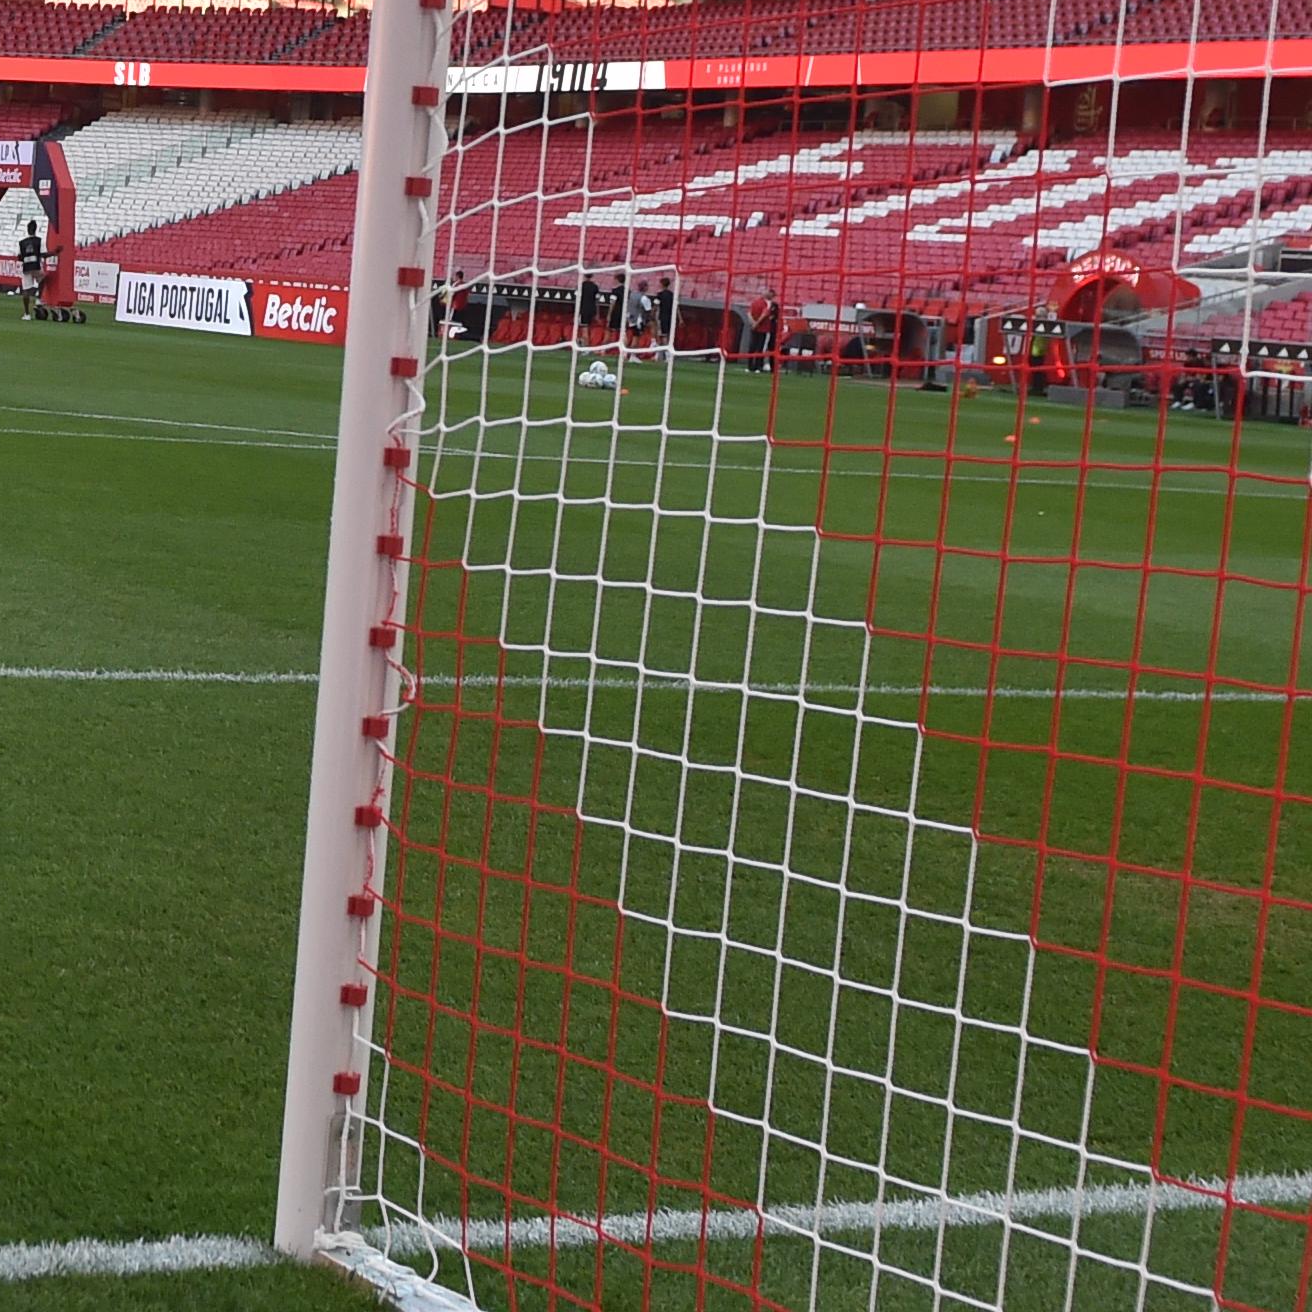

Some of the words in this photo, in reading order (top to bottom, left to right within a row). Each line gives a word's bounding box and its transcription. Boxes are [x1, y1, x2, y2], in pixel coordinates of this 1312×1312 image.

[114, 62, 151, 86] SLB
[126, 280, 155, 317] LIGA
[159, 285, 231, 325] PORTUGAL
[263, 293, 338, 335] Betclic
